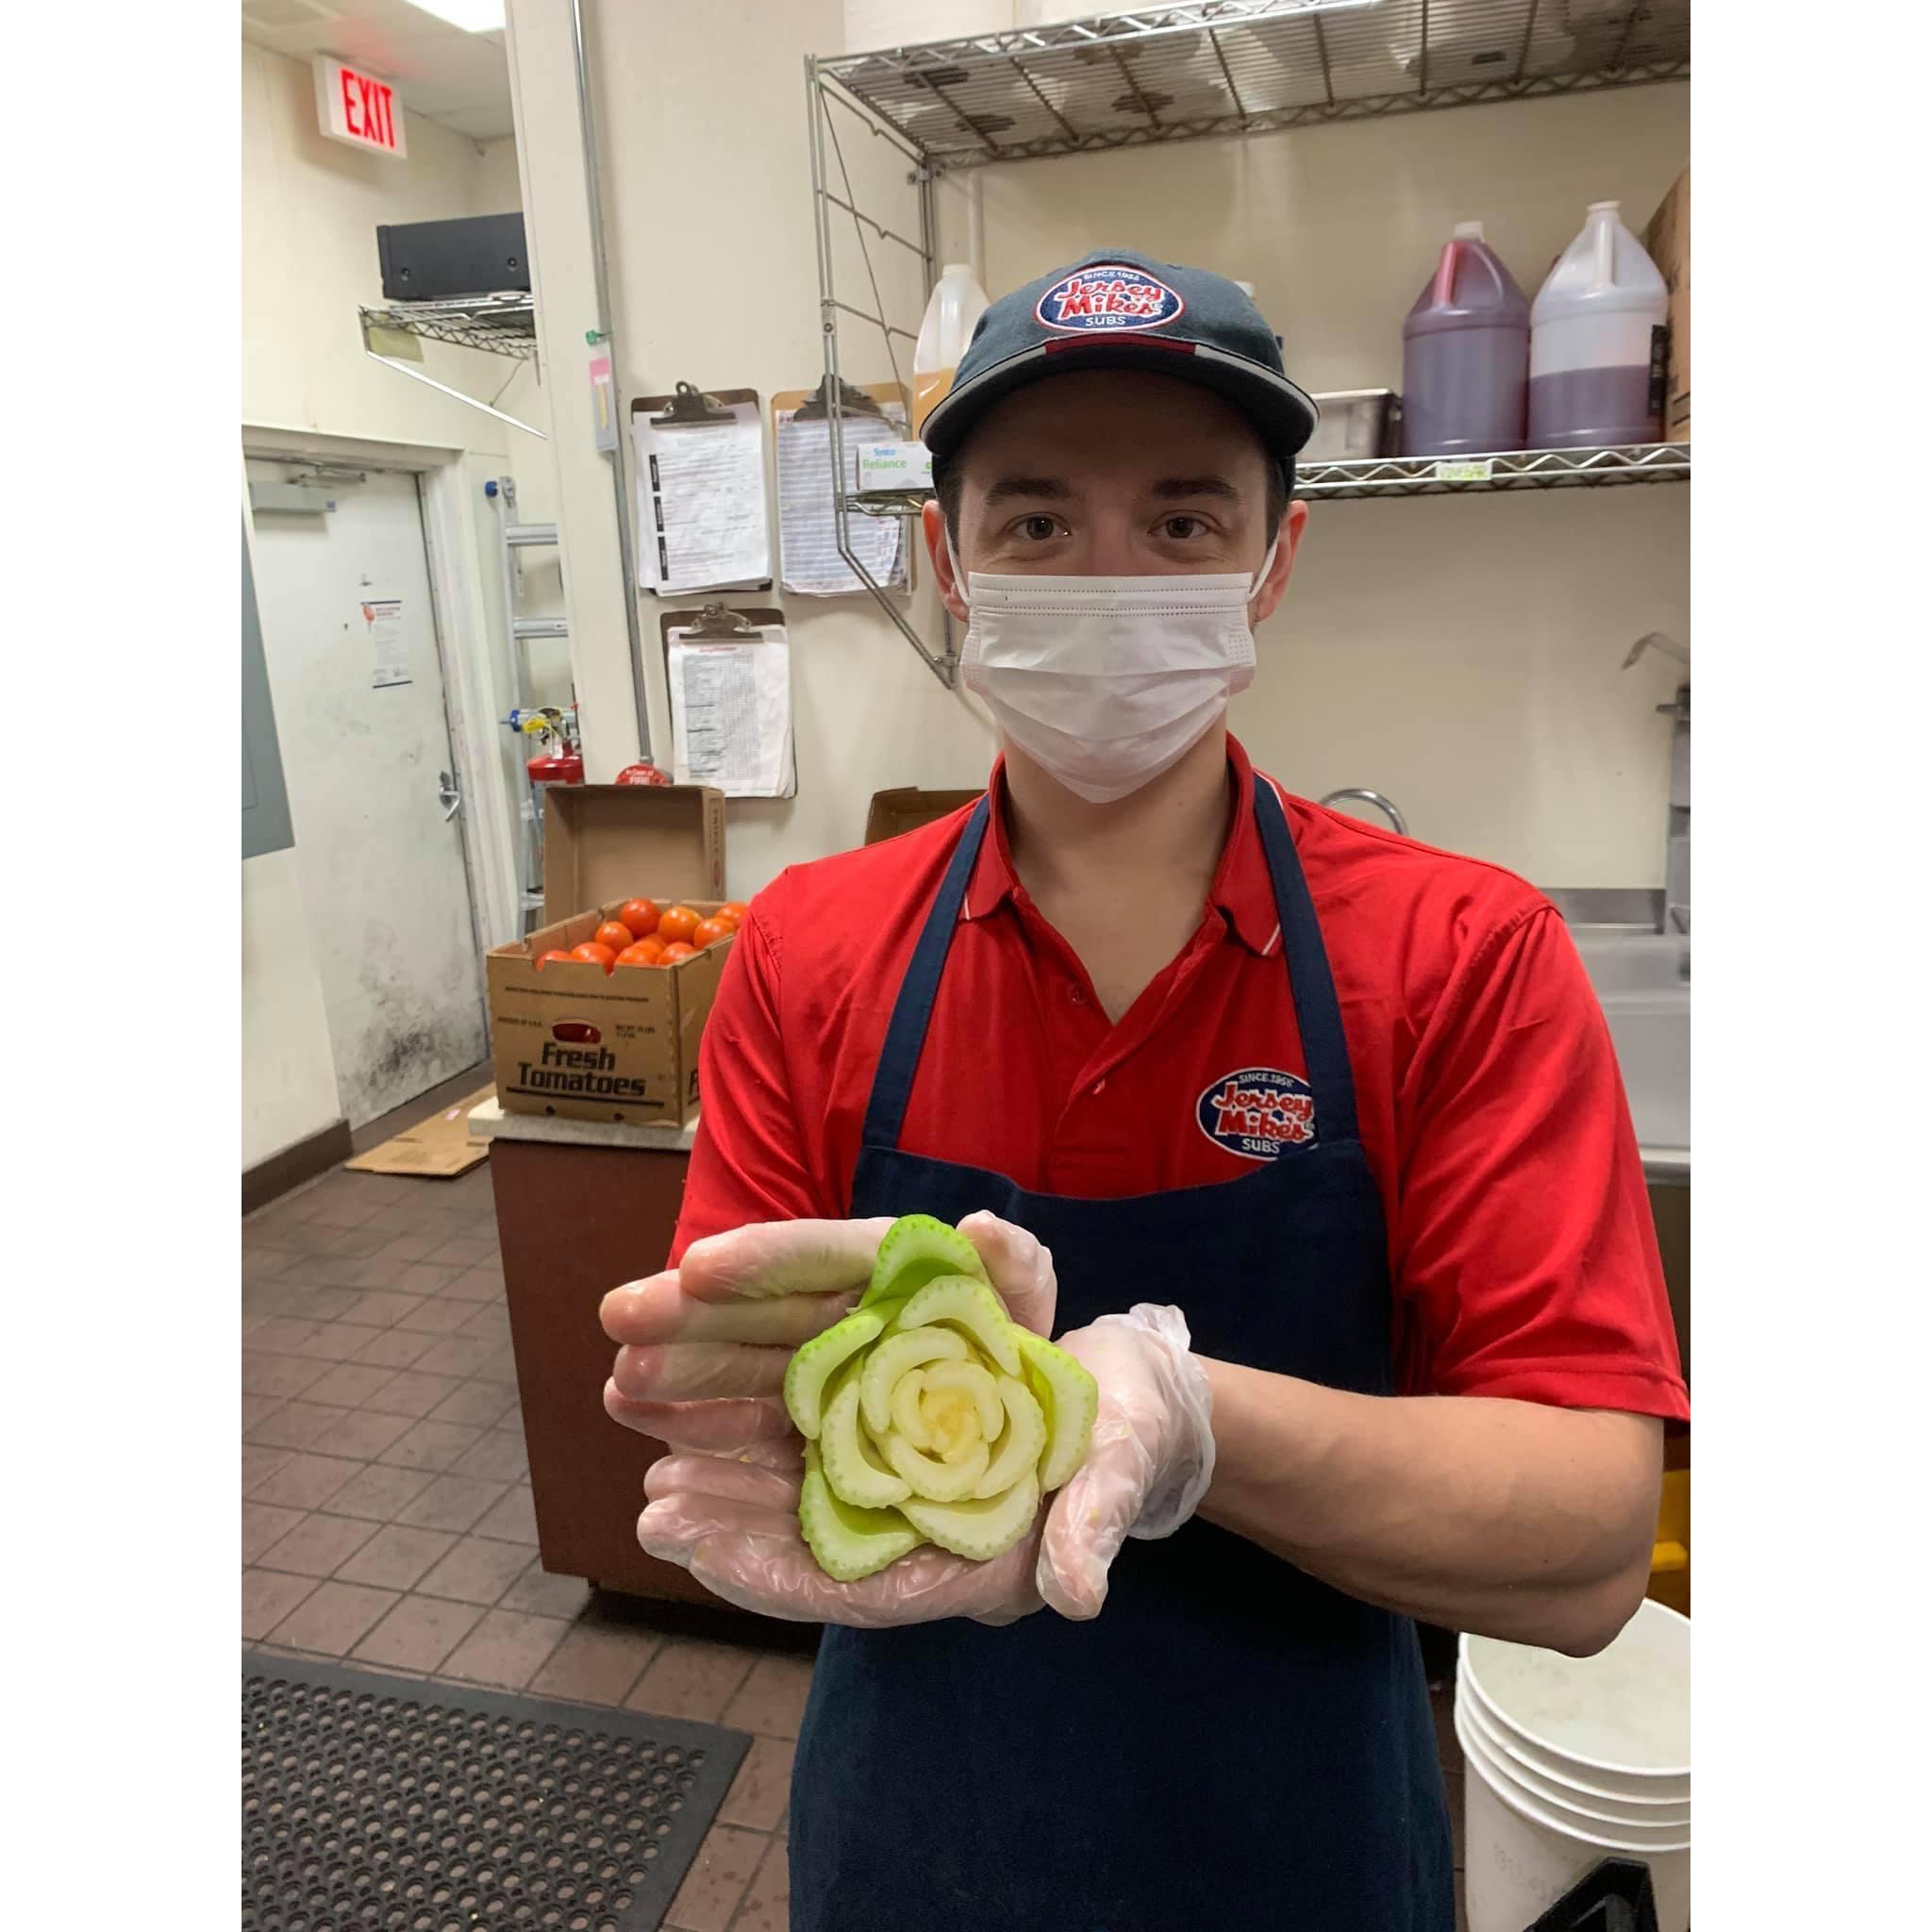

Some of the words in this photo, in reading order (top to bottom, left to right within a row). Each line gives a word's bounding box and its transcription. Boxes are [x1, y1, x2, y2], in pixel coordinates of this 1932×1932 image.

[341, 68, 394, 148] EXIT
[1083, 271, 1116, 279] SINCE
[1057, 278, 1164, 302] Jersey
[1086, 316, 1126, 326] SUBS
[862, 458, 907, 471] Reliance
[541, 1041, 616, 1072] Fresh
[518, 1061, 647, 1096] Tomatoes
[1239, 1073, 1268, 1084] SINCE
[1212, 1082, 1313, 1122] Jersey
[1241, 1138, 1281, 1154] SUBS
